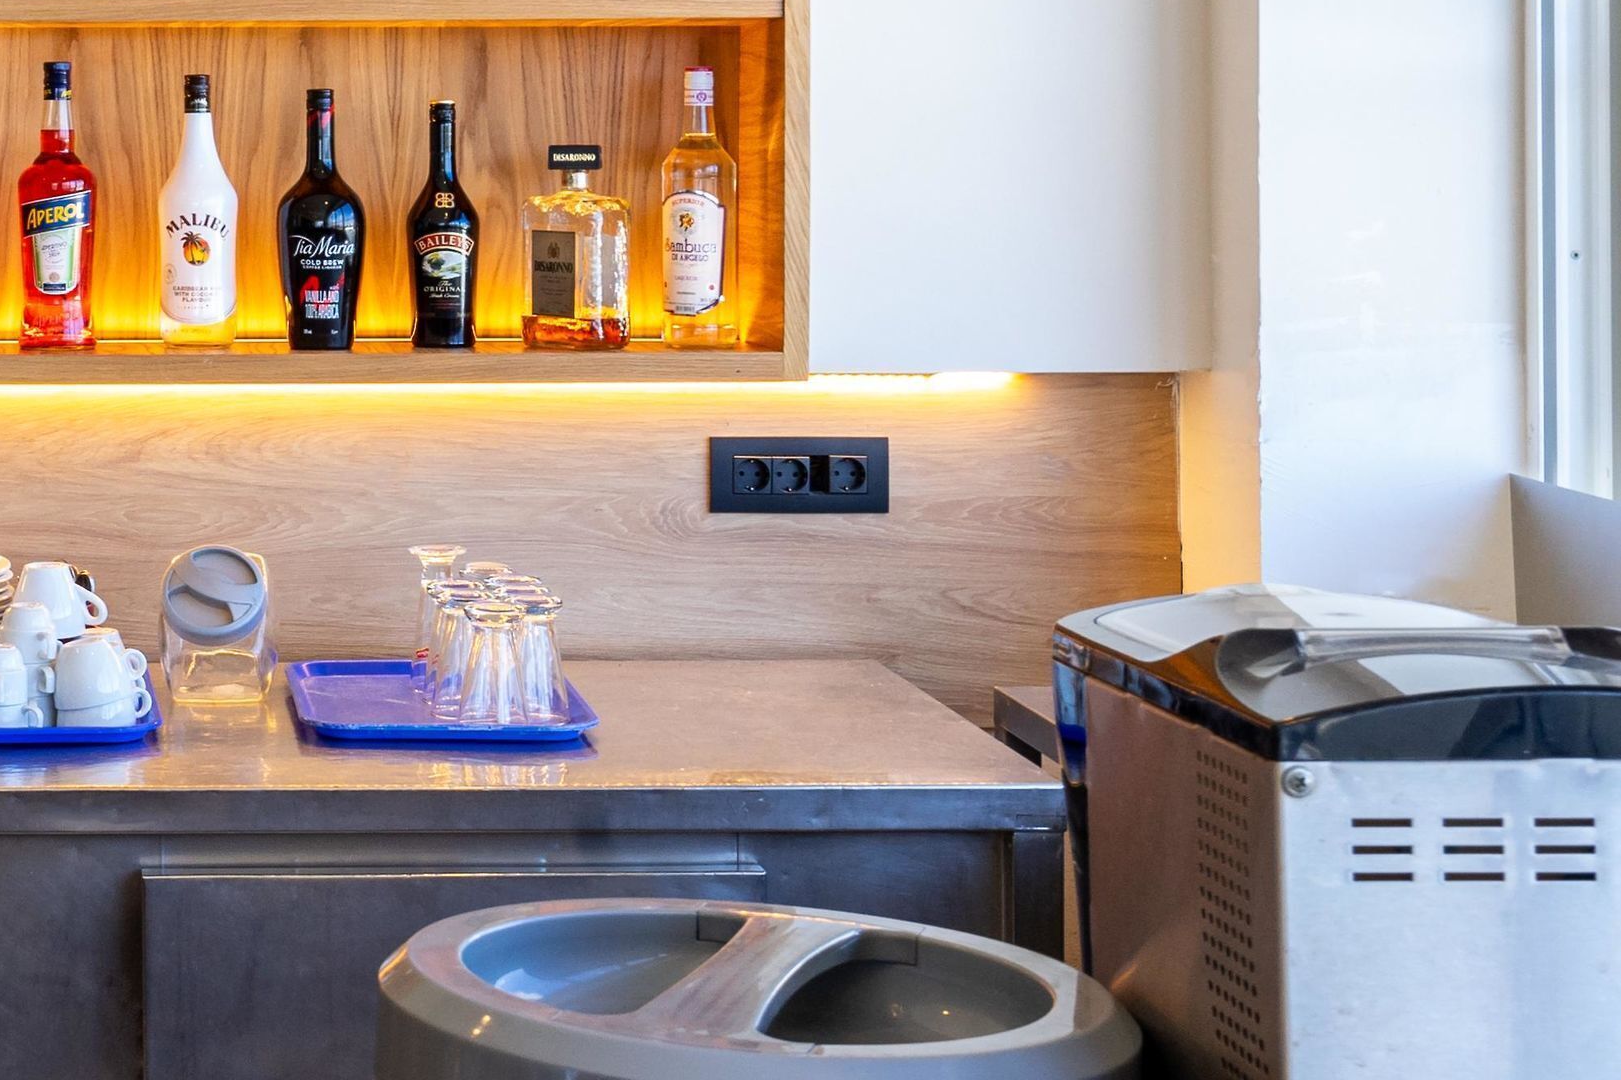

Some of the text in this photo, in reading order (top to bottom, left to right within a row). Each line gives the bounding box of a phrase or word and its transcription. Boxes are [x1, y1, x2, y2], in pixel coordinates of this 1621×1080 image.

[553, 153, 596, 162] DISARONNO
[27, 201, 85, 231] APEROL
[165, 212, 230, 240] MALIBU
[309, 235, 355, 258] Maria
[418, 235, 471, 251] BAILEYS
[534, 260, 573, 273] DISARONNO
